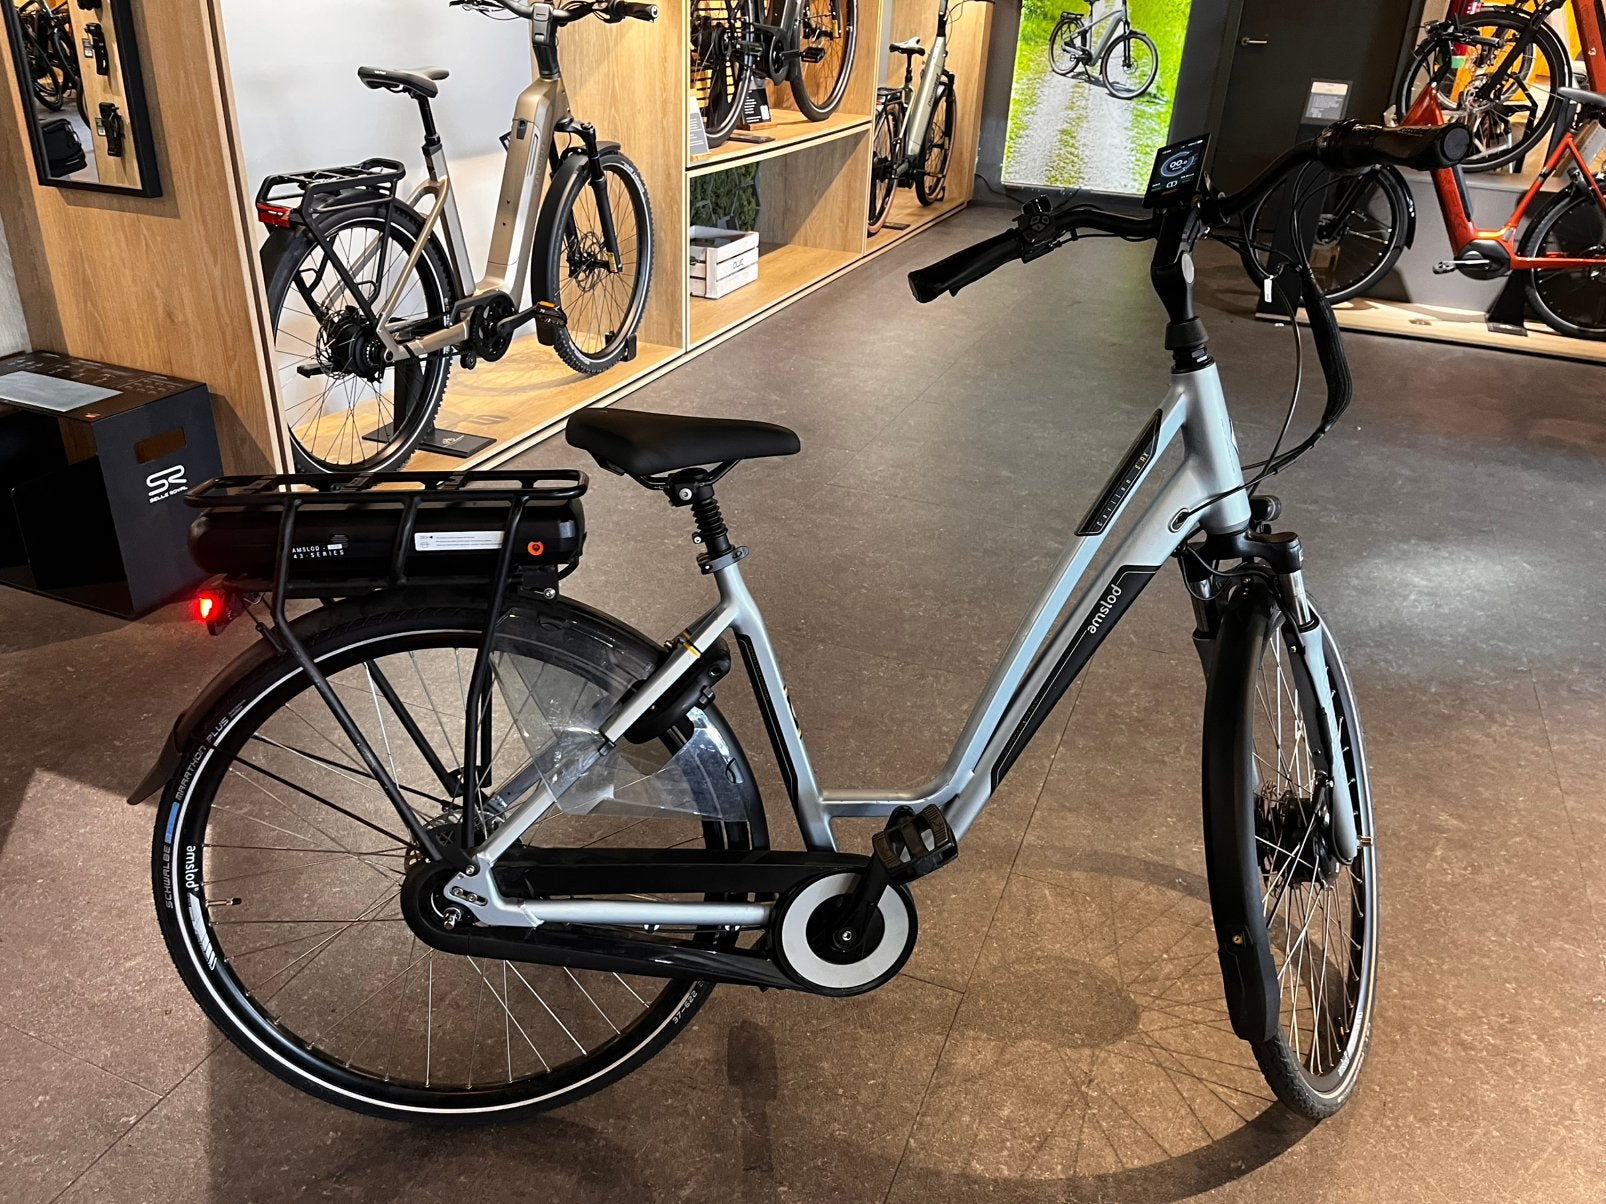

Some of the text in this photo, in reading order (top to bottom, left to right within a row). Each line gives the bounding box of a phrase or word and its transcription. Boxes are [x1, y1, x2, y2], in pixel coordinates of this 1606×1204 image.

[1087, 583, 1122, 634] amslod
[164, 844, 174, 909] SCHWALBE
[175, 744, 207, 801] MARATHON
[206, 716, 229, 743] PLUS
[185, 845, 198, 891] amslod
[672, 990, 698, 1024] 37-622
